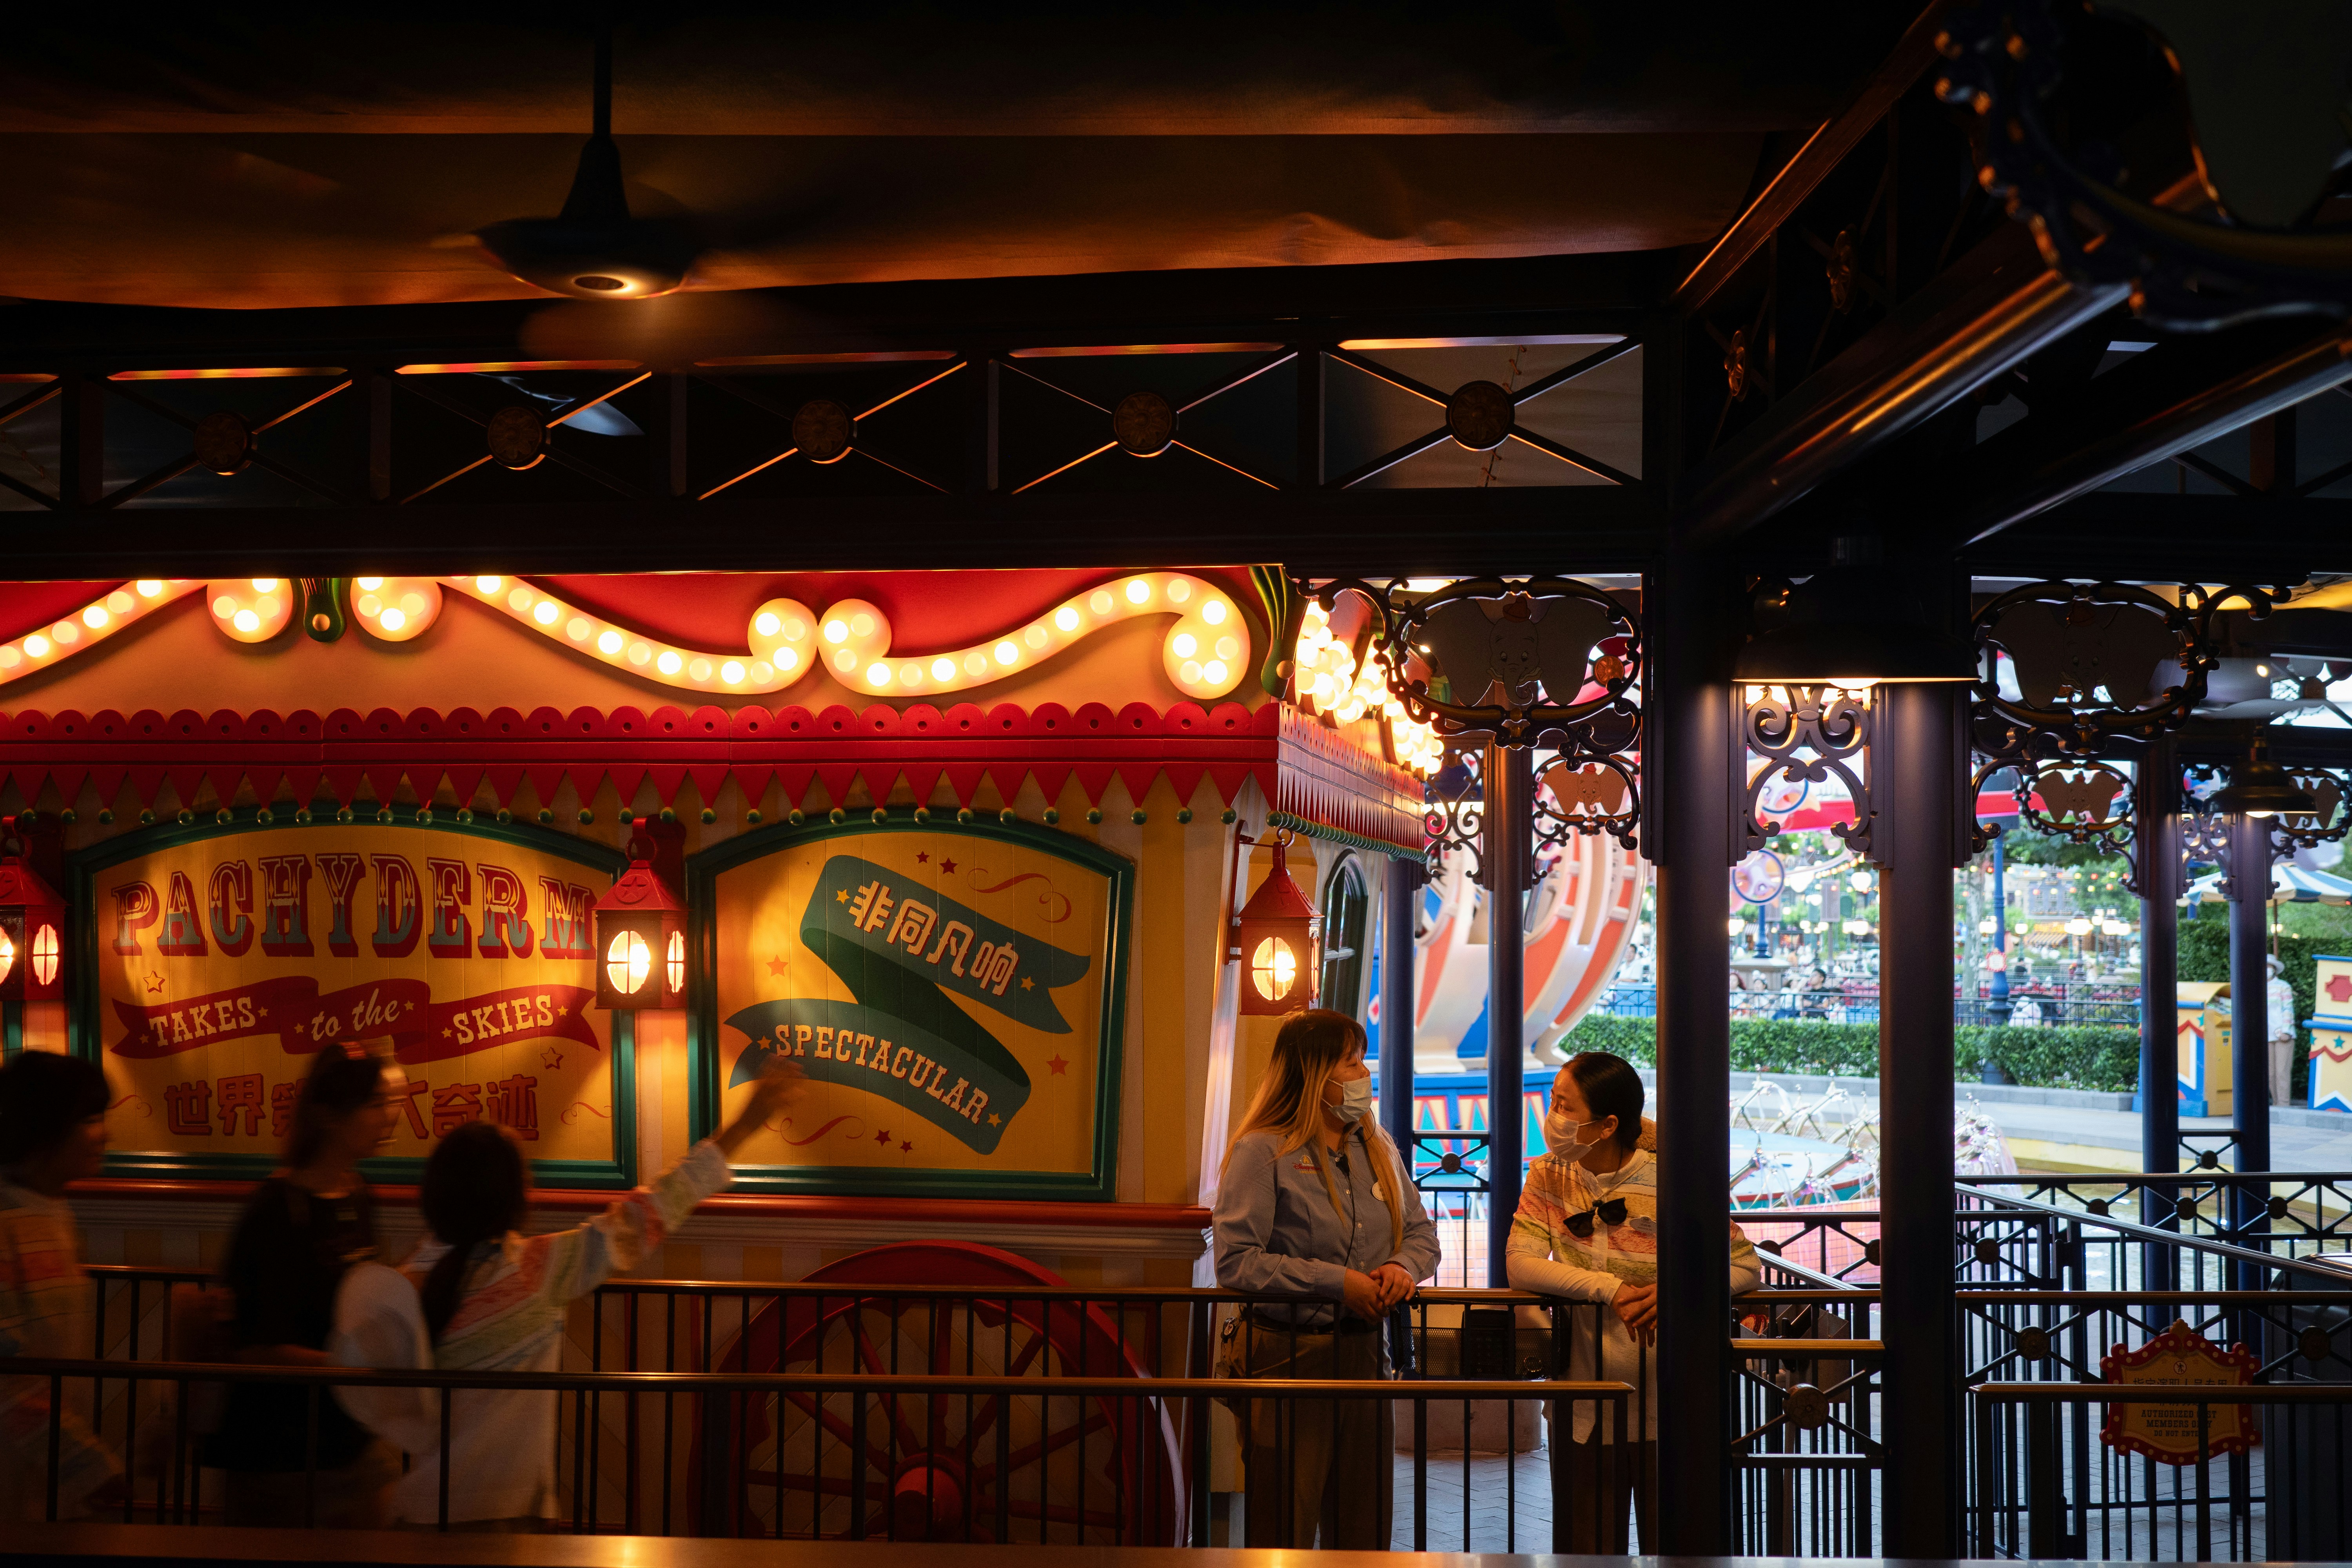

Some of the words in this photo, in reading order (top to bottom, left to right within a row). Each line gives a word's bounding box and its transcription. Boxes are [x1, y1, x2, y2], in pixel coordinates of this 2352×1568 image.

[111, 852, 598, 960] PACHYDERM
[848, 880, 1020, 997] 非同凡响
[149, 996, 256, 1047] TAKES
[311, 1011, 341, 1041] to
[352, 988, 400, 1031] the
[453, 995, 554, 1045] SKIES
[775, 1024, 989, 1125] SPECTACULAR
[2141, 1410, 2194, 1418] AUTHORIZED
[2197, 1410, 2217, 1418] ST
[2146, 1419, 2189, 1428] MEMBERS
[2191, 1420, 2212, 1428] OY
